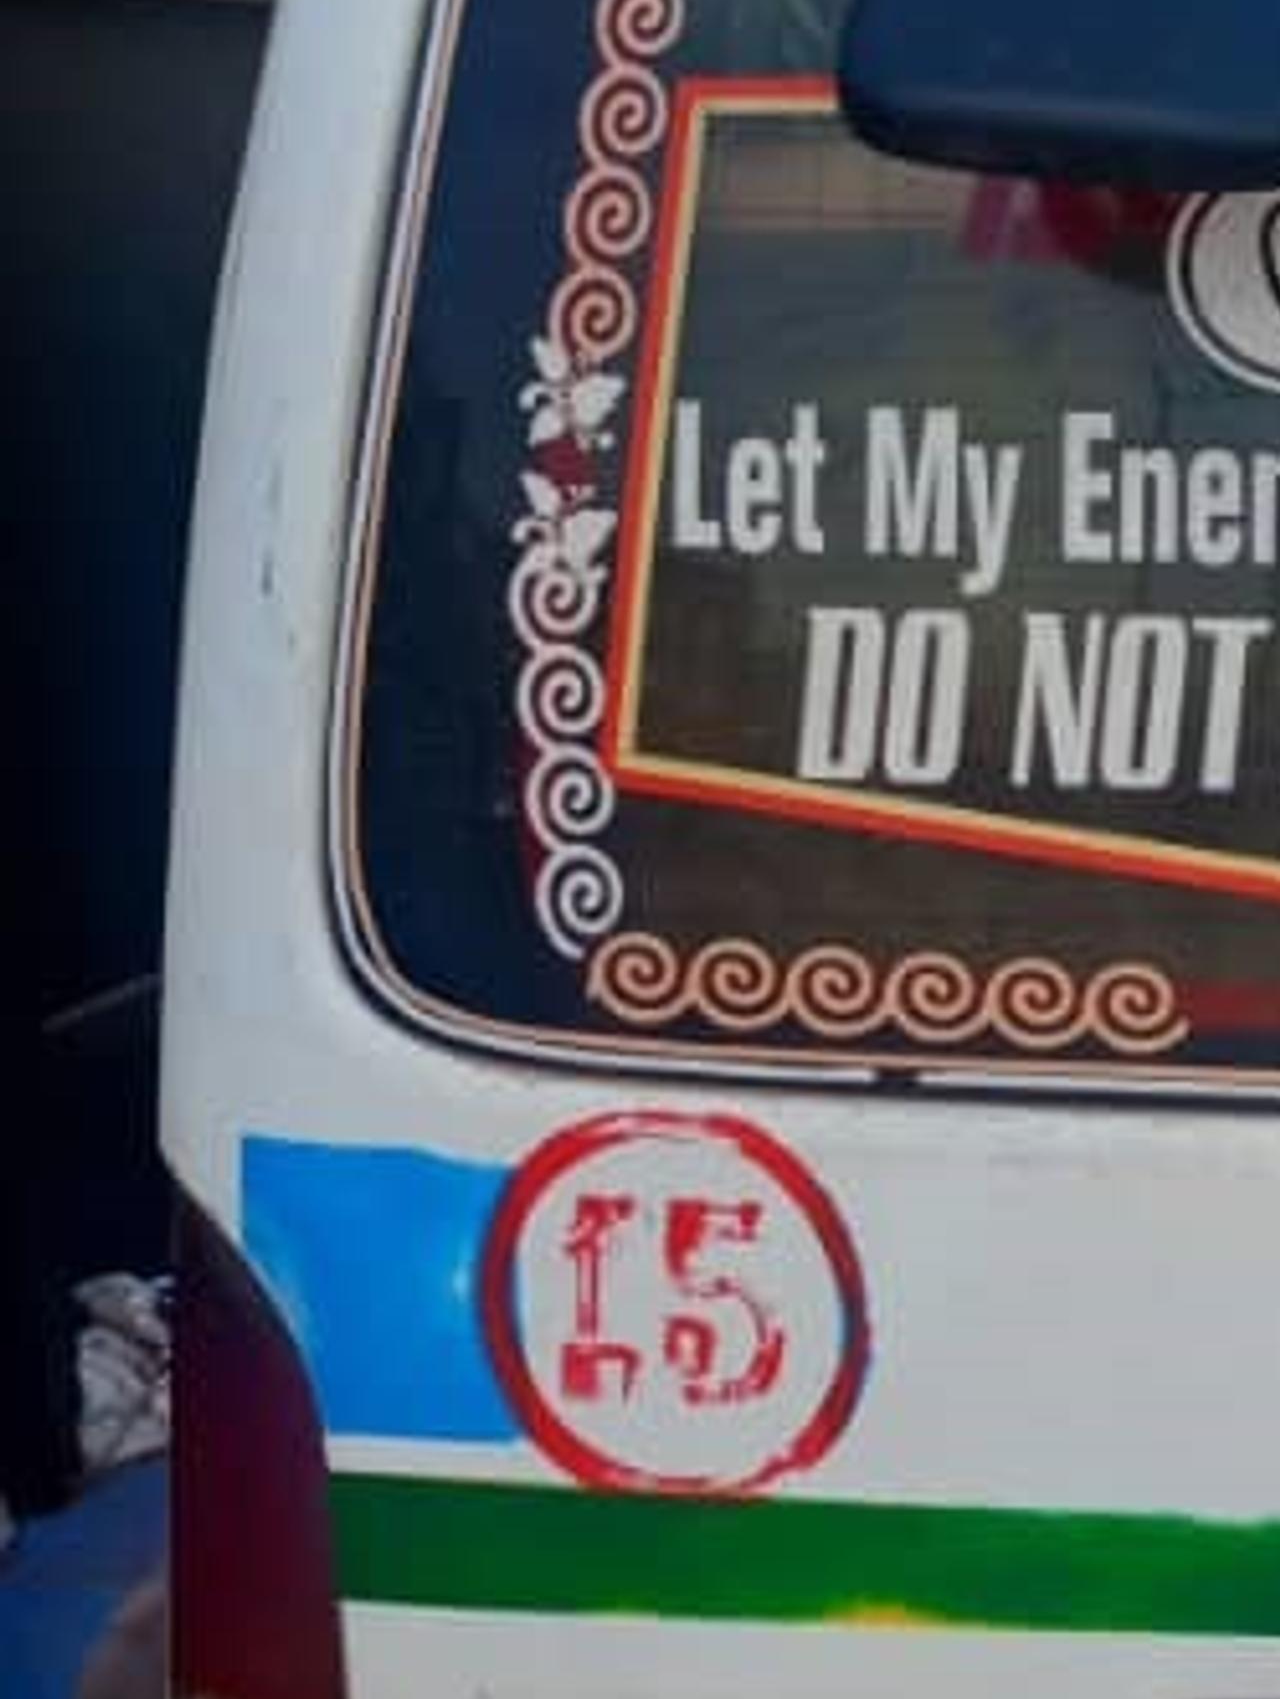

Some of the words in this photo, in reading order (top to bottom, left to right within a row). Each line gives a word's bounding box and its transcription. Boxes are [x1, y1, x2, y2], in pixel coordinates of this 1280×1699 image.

[670, 398, 825, 555] Let
[864, 408, 1022, 596] My
[805, 606, 970, 786] DO
[1010, 610, 1272, 792] NOT
[560, 1192, 786, 1406] 15
